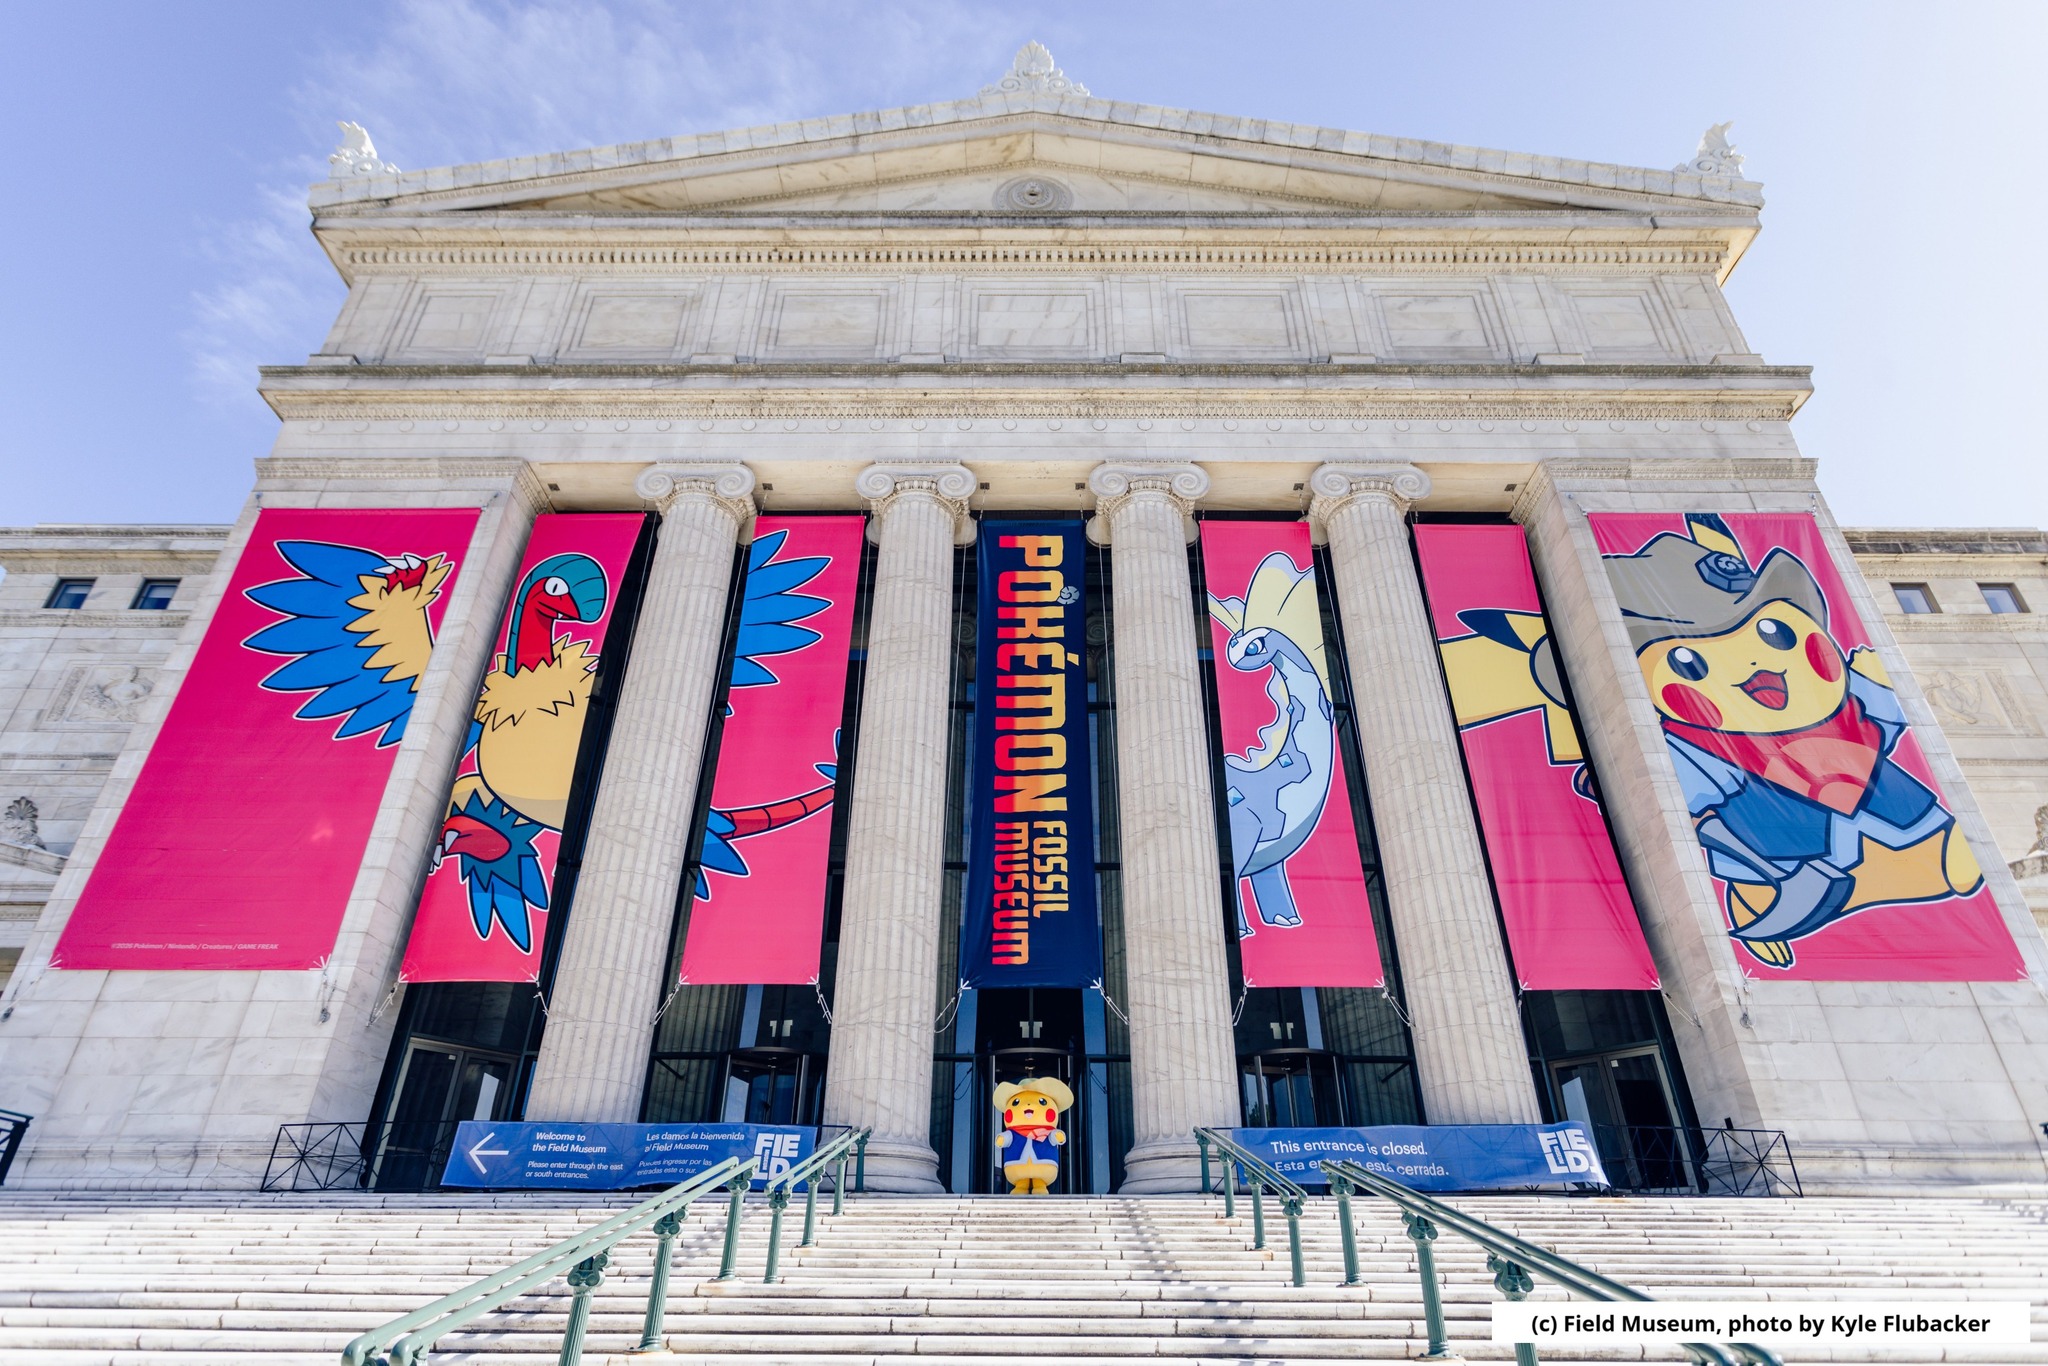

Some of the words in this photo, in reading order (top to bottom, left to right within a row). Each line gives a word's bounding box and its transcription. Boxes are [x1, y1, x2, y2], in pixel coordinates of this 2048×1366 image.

[994, 535, 1079, 813] POKÉMON
[1033, 820, 1069, 918] FOSSIL
[992, 822, 1029, 965] MUSEUM
[536, 1132, 575, 1141] Welcome
[577, 1134, 586, 1142] to
[646, 1133, 660, 1141] Les
[661, 1132, 689, 1140] damos
[690, 1132, 699, 1140] la
[700, 1132, 745, 1140] bienvenida
[1537, 1129, 1589, 1154] FIE
[532, 1143, 546, 1152] the
[547, 1143, 569, 1152] Field
[570, 1145, 607, 1153] Museum
[652, 1143, 673, 1152] Field
[673, 1143, 709, 1151] Museum
[754, 1133, 801, 1158] FIE
[1270, 1140, 1300, 1154] This
[1303, 1140, 1364, 1152] entrance
[1365, 1142, 1379, 1155] is
[1381, 1141, 1428, 1155] closed.
[569, 1162, 596, 1171] through
[662, 1158, 689, 1167] ingresar
[689, 1159, 702, 1167] por
[702, 1158, 713, 1166] las
[637, 1167, 663, 1176] entradas
[1275, 1161, 1305, 1172] Esta
[1366, 1160, 1395, 1173] está
[1396, 1162, 1450, 1176] cerrada.
[534, 1170, 553, 1178] south
[554, 1171, 590, 1179] entrances.
